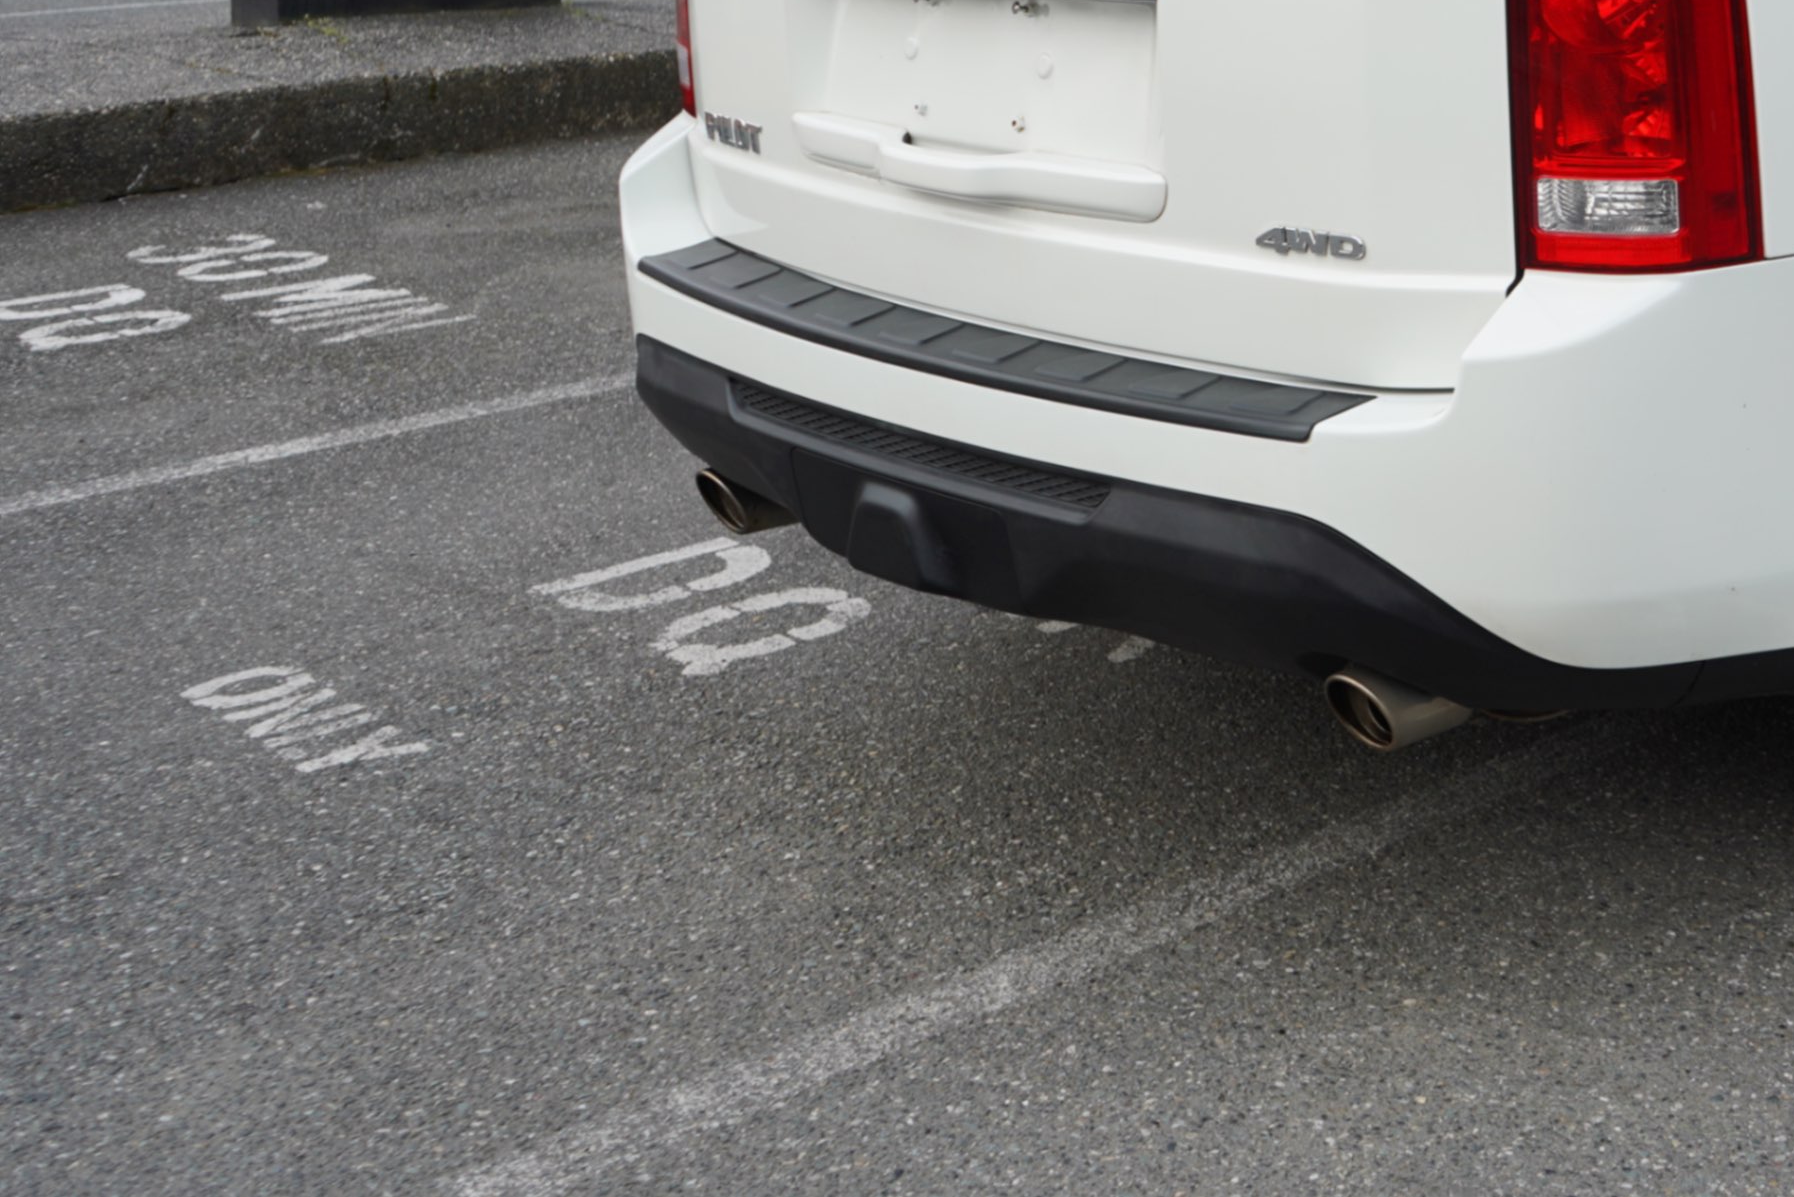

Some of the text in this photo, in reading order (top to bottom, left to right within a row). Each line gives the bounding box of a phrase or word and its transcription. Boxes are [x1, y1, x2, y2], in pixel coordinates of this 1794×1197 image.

[704, 111, 763, 155] PILOT
[1255, 226, 1367, 261] 4WD
[126, 233, 477, 344] 30 MIN
[180, 666, 430, 773] ONLY
